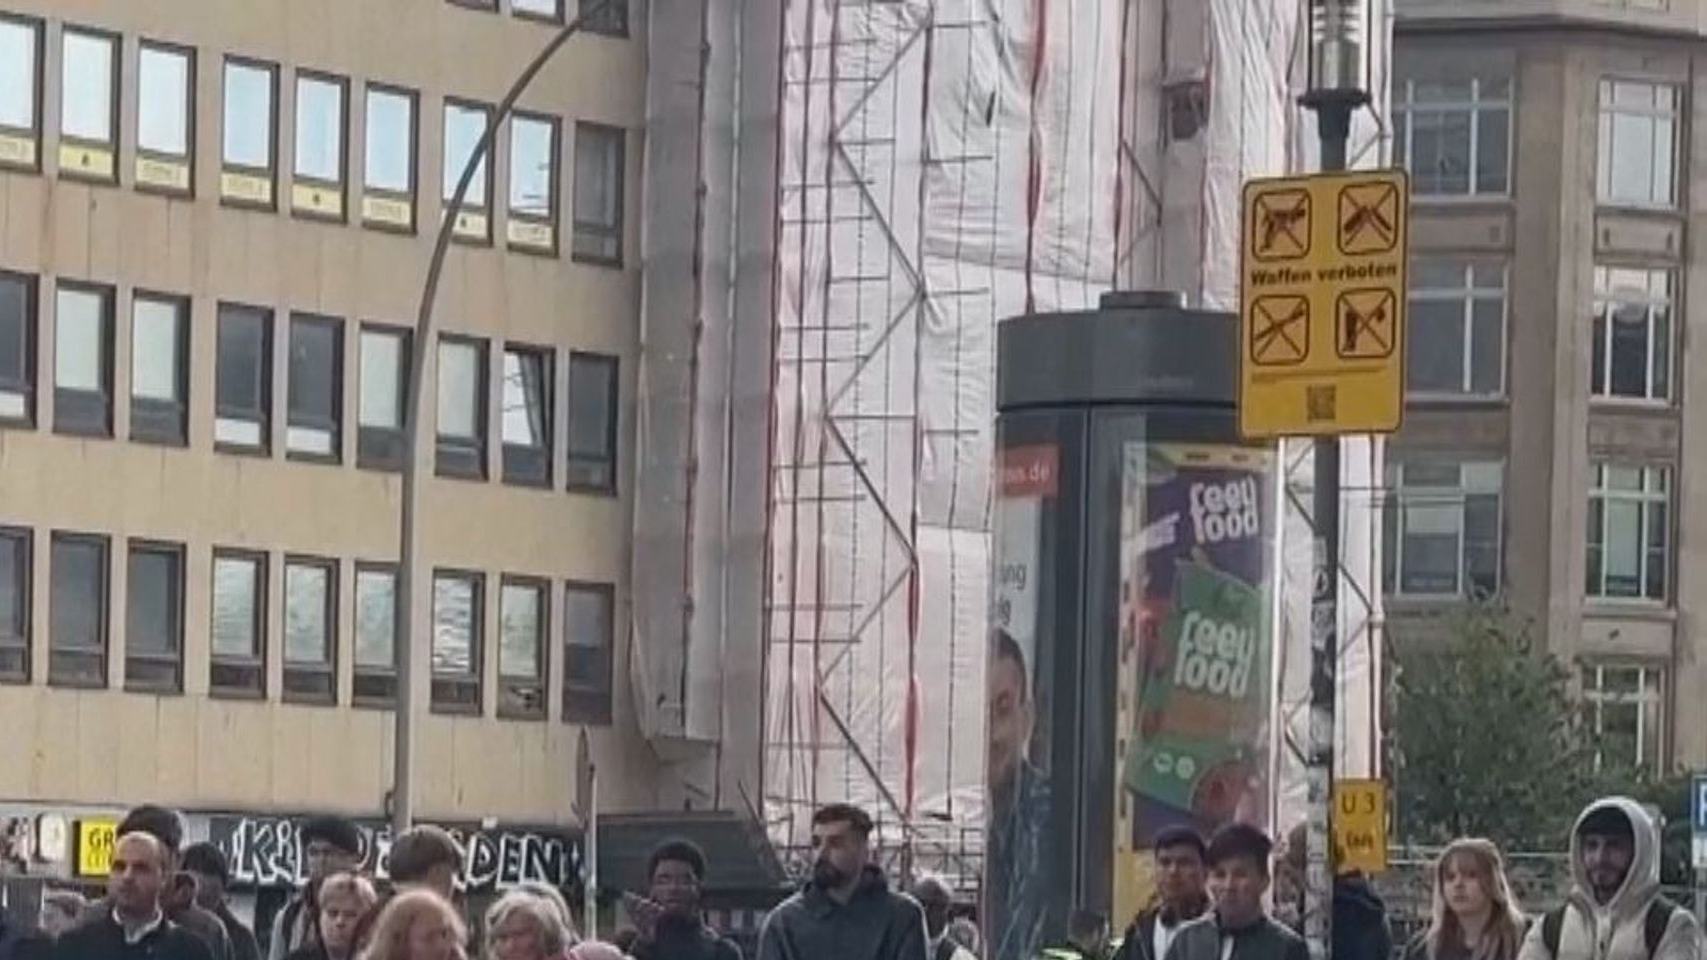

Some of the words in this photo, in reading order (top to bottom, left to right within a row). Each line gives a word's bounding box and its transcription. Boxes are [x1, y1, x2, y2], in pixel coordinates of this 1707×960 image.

[1250, 267, 1313, 285] Waffen
[1317, 261, 1398, 281] verboten
[1341, 792, 1356, 815] U
[1365, 791, 1376, 814] 3
